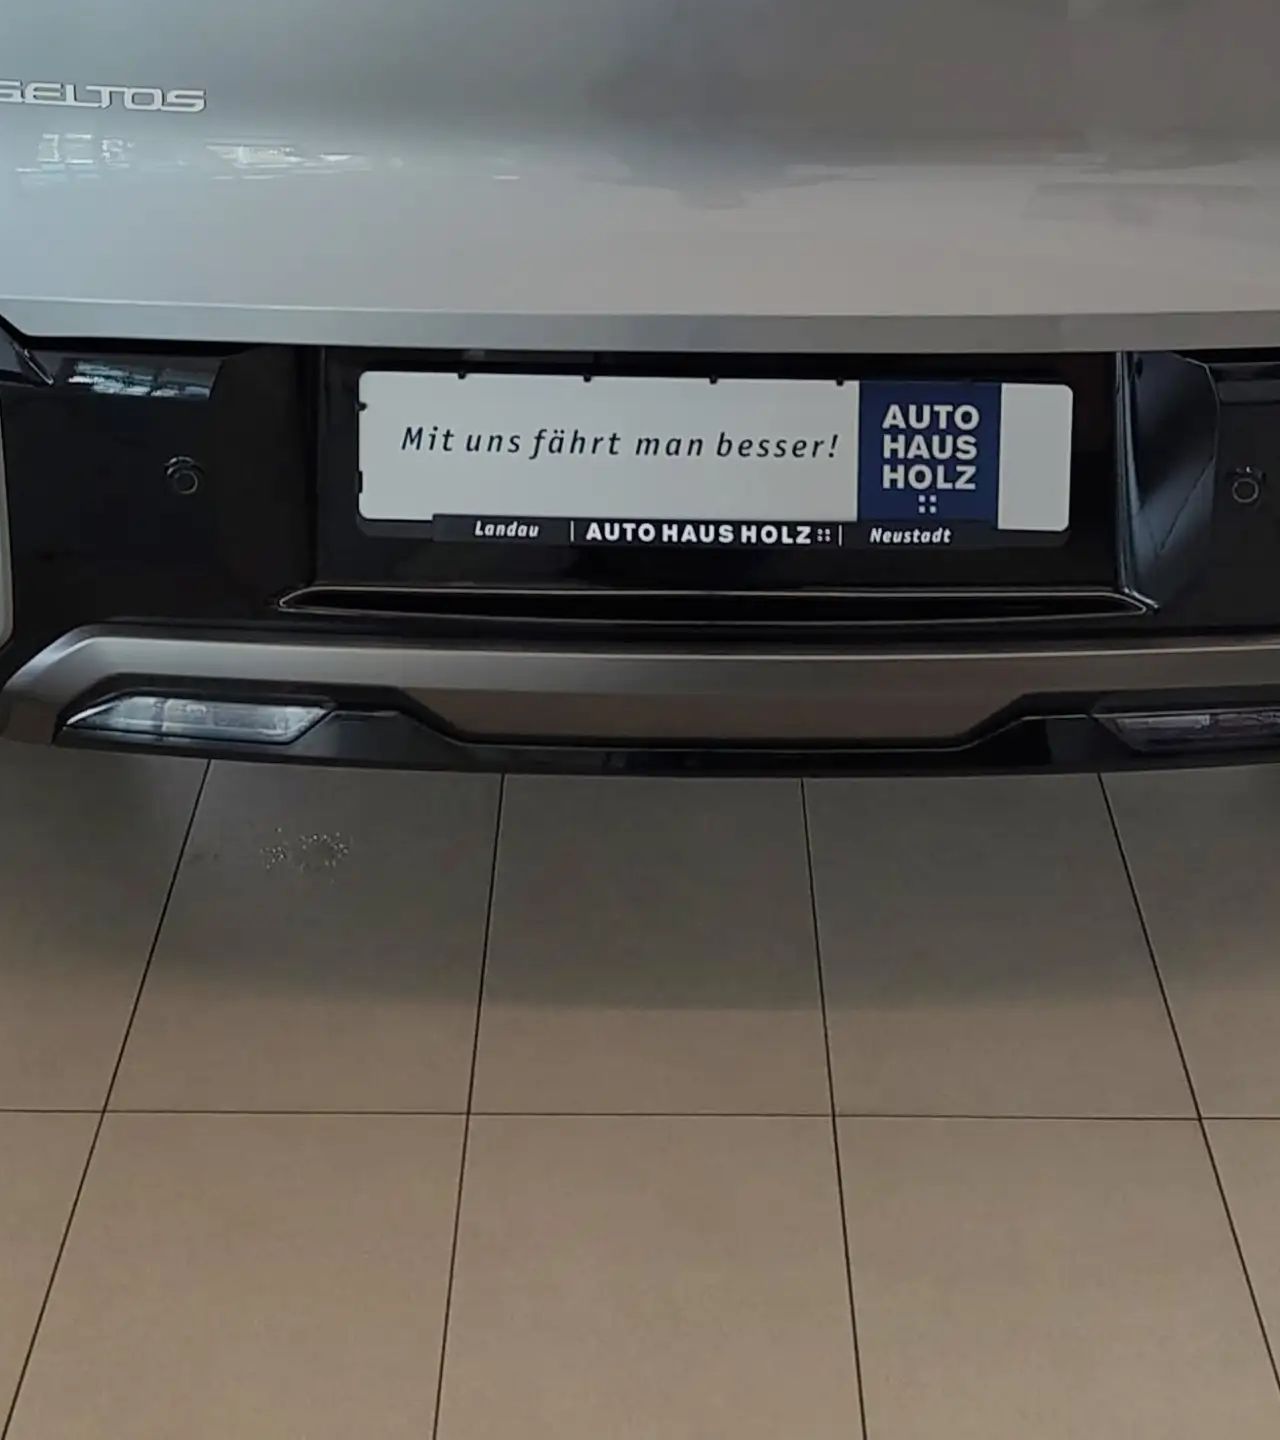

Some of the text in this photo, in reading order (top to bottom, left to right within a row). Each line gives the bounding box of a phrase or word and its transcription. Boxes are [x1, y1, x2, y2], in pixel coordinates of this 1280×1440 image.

[882, 404, 980, 430] AUTO
[401, 426, 840, 459] Mit uns fährt man besser!
[883, 434, 978, 460] HAUS
[882, 464, 977, 490] HOLZ
[474, 521, 952, 545] Landau AUTO HAUS HOLZ Neustadt
